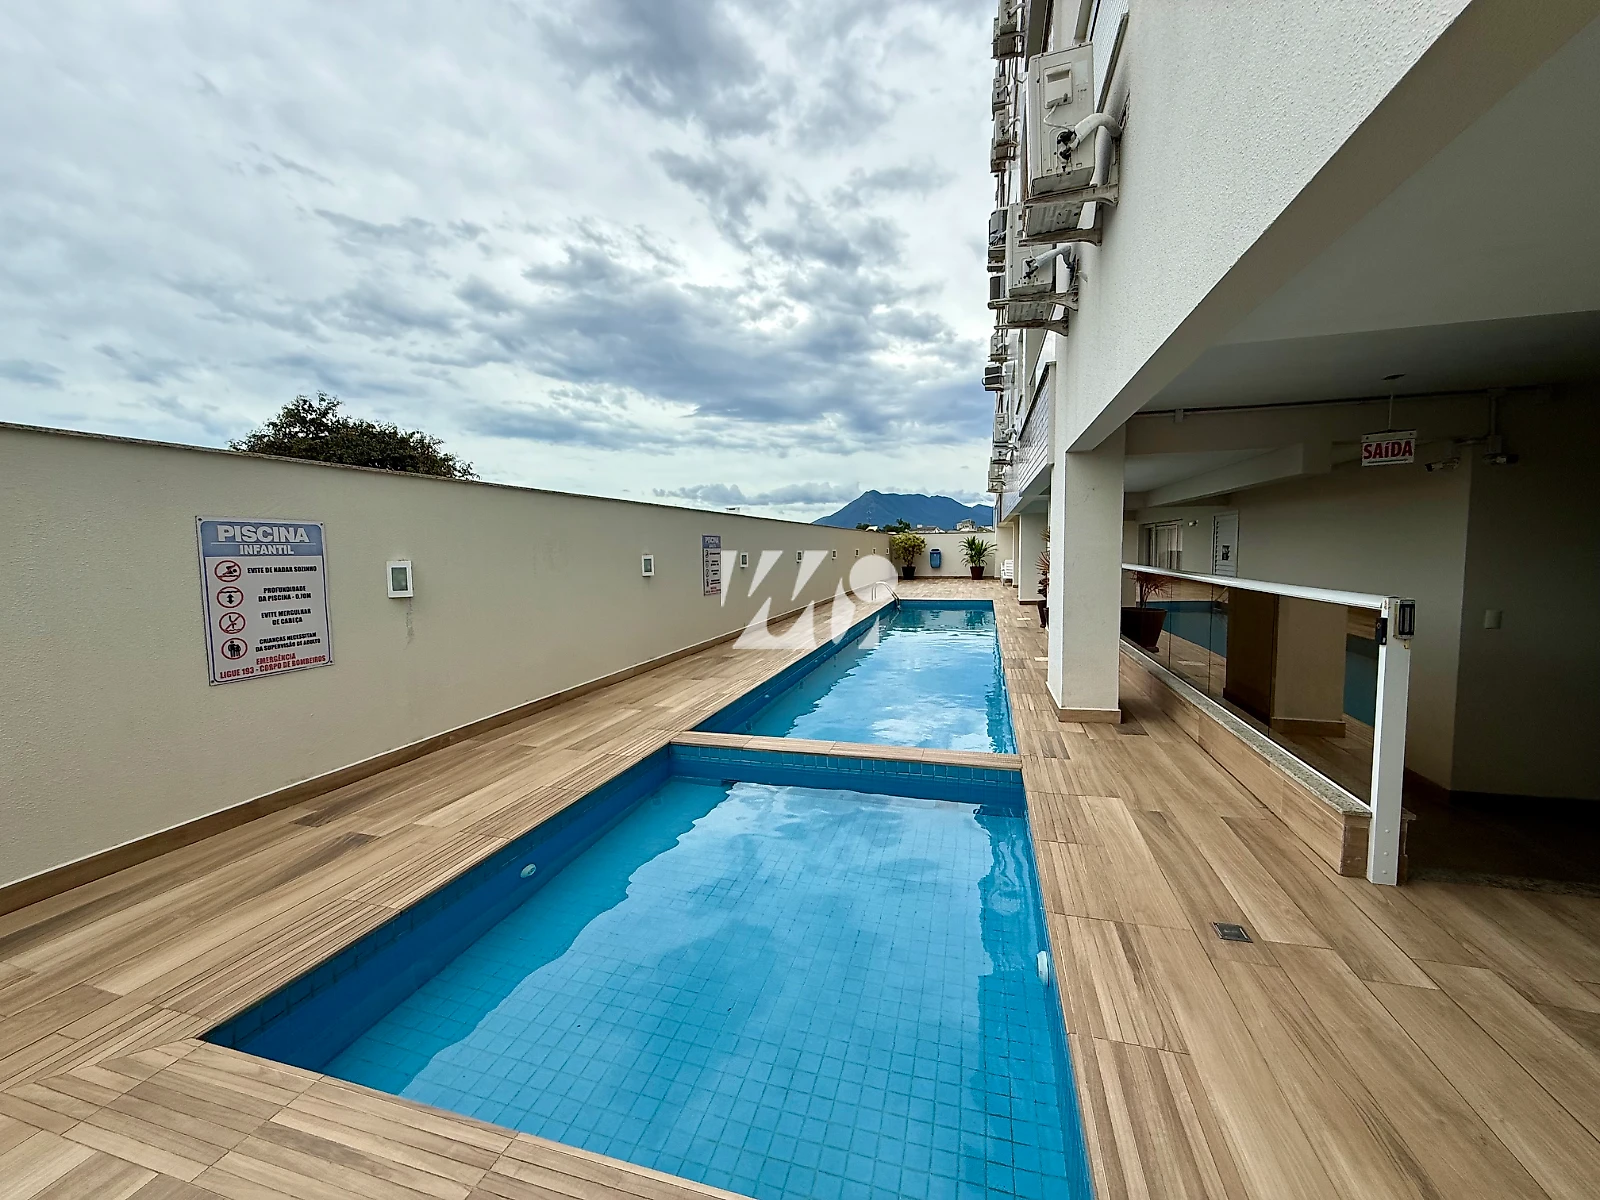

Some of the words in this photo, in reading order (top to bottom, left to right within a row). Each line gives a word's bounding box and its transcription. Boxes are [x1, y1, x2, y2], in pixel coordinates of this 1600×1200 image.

[1364, 440, 1412, 459] SAÍDA
[217, 524, 310, 543] PISCINA
[240, 544, 294, 555] INFANTIL
[220, 669, 241, 679] LIGUE
[242, 667, 254, 676] 193
[260, 663, 282, 673] CORPO
[292, 655, 326, 667] BOMBEIROS
[256, 653, 297, 665] EMERGÊNCIA
